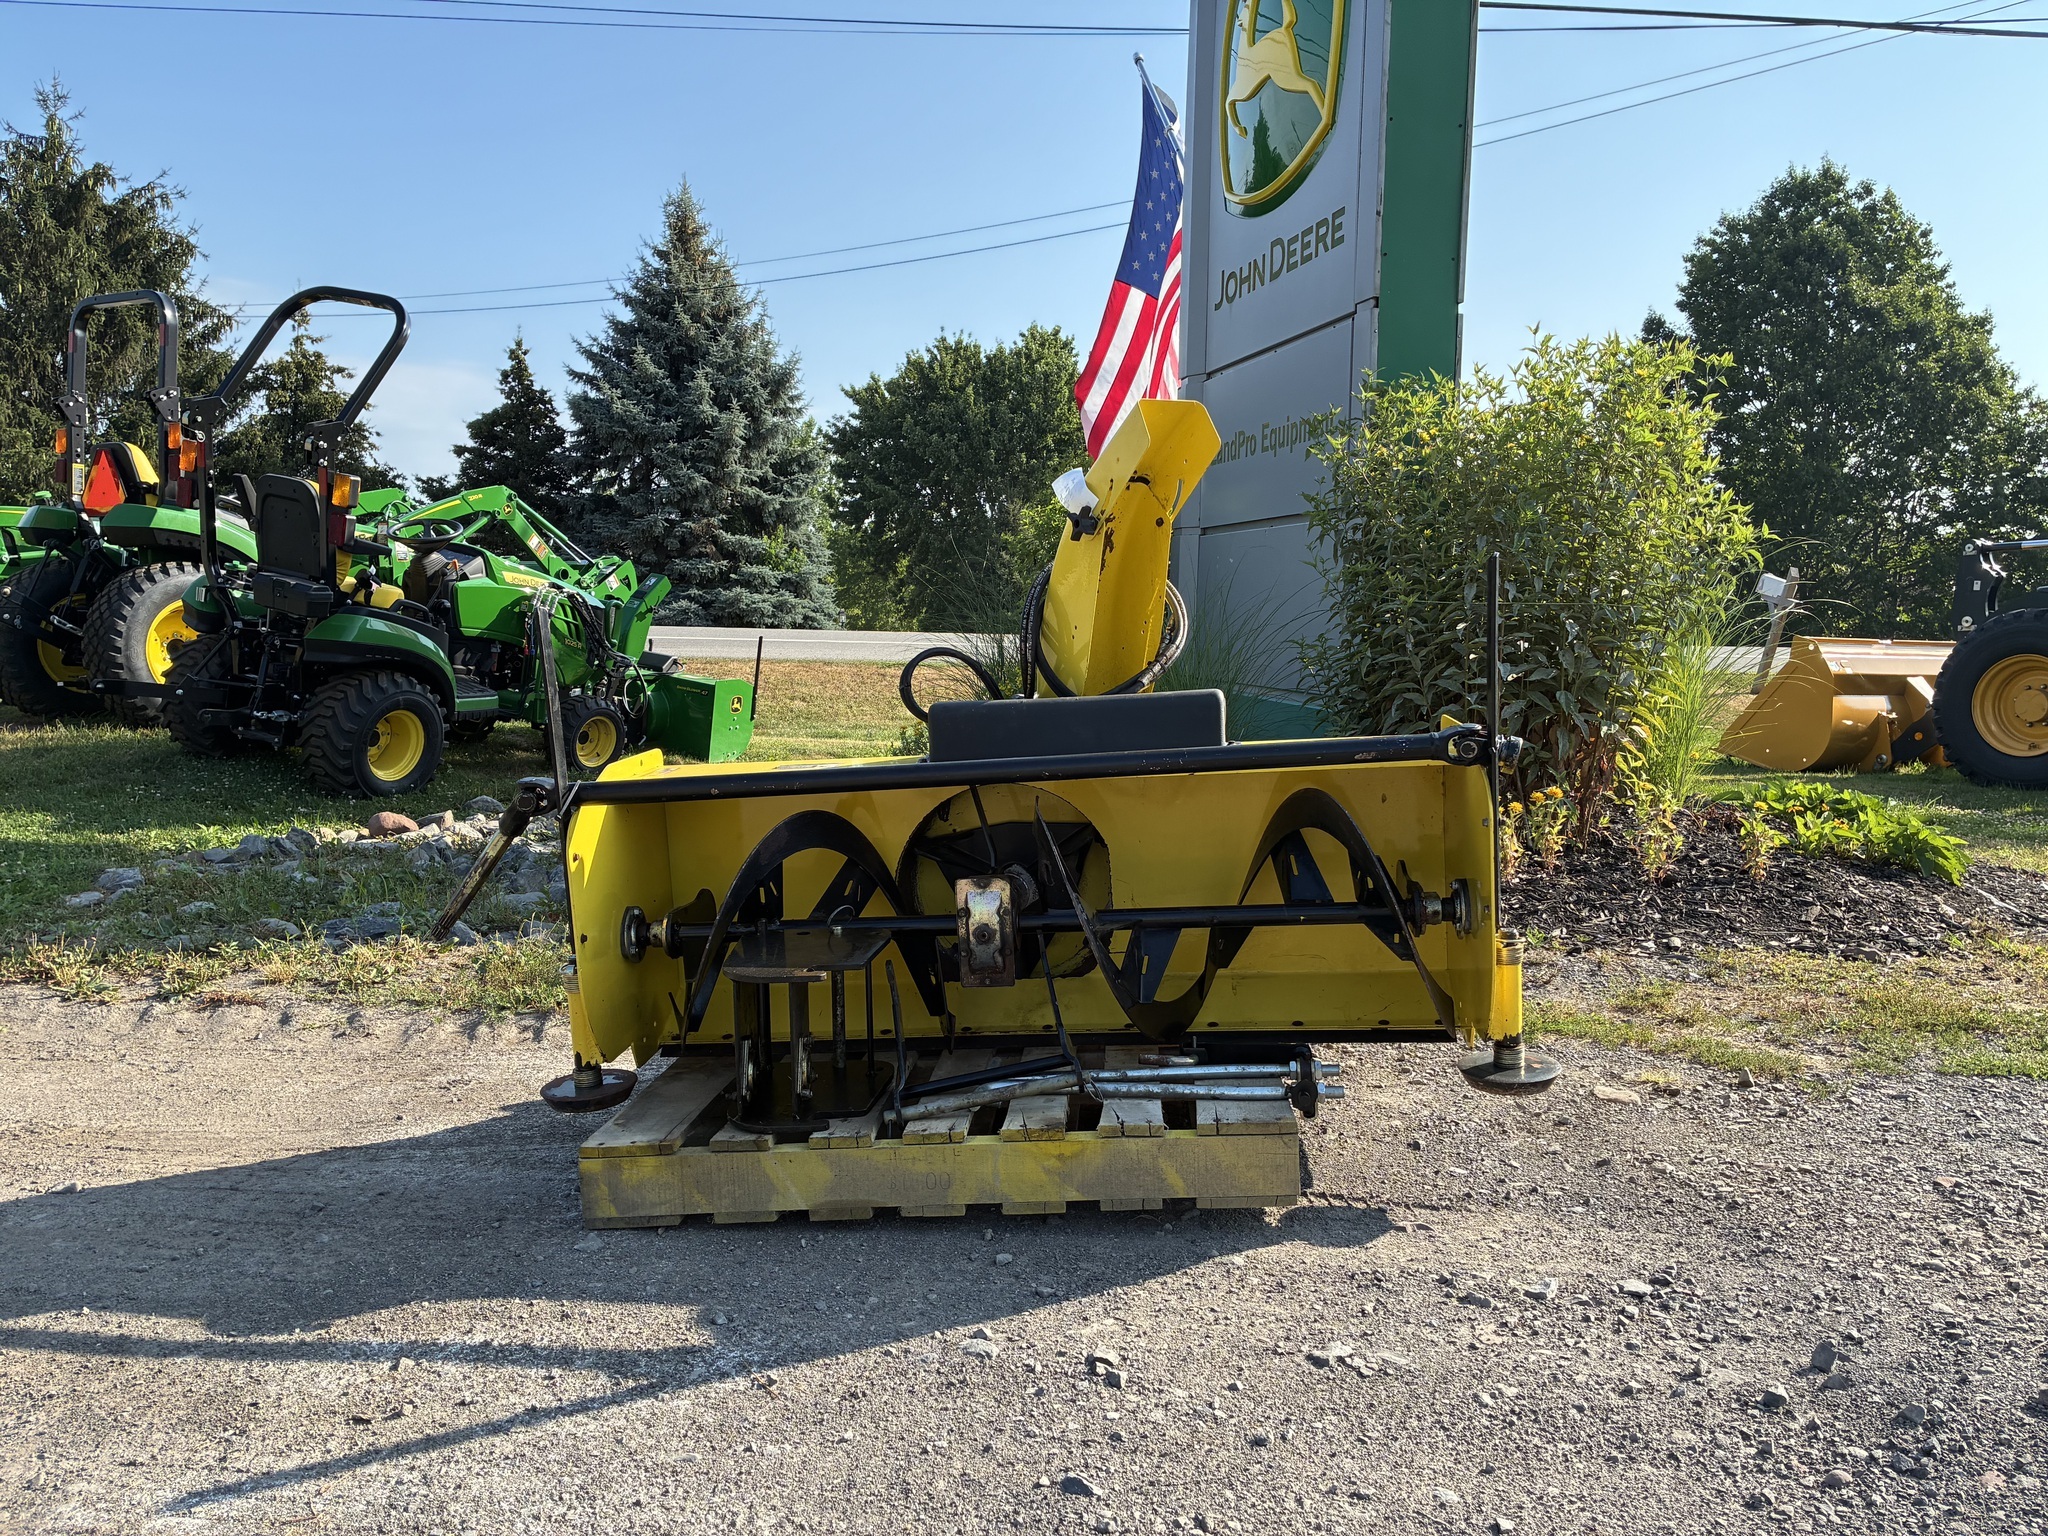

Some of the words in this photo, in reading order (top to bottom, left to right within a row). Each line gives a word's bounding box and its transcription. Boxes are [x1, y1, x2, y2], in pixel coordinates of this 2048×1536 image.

[1214, 253, 1266, 311] JOHN
[1269, 206, 1346, 283] DEERE
[510, 575, 529, 587] JOHN
